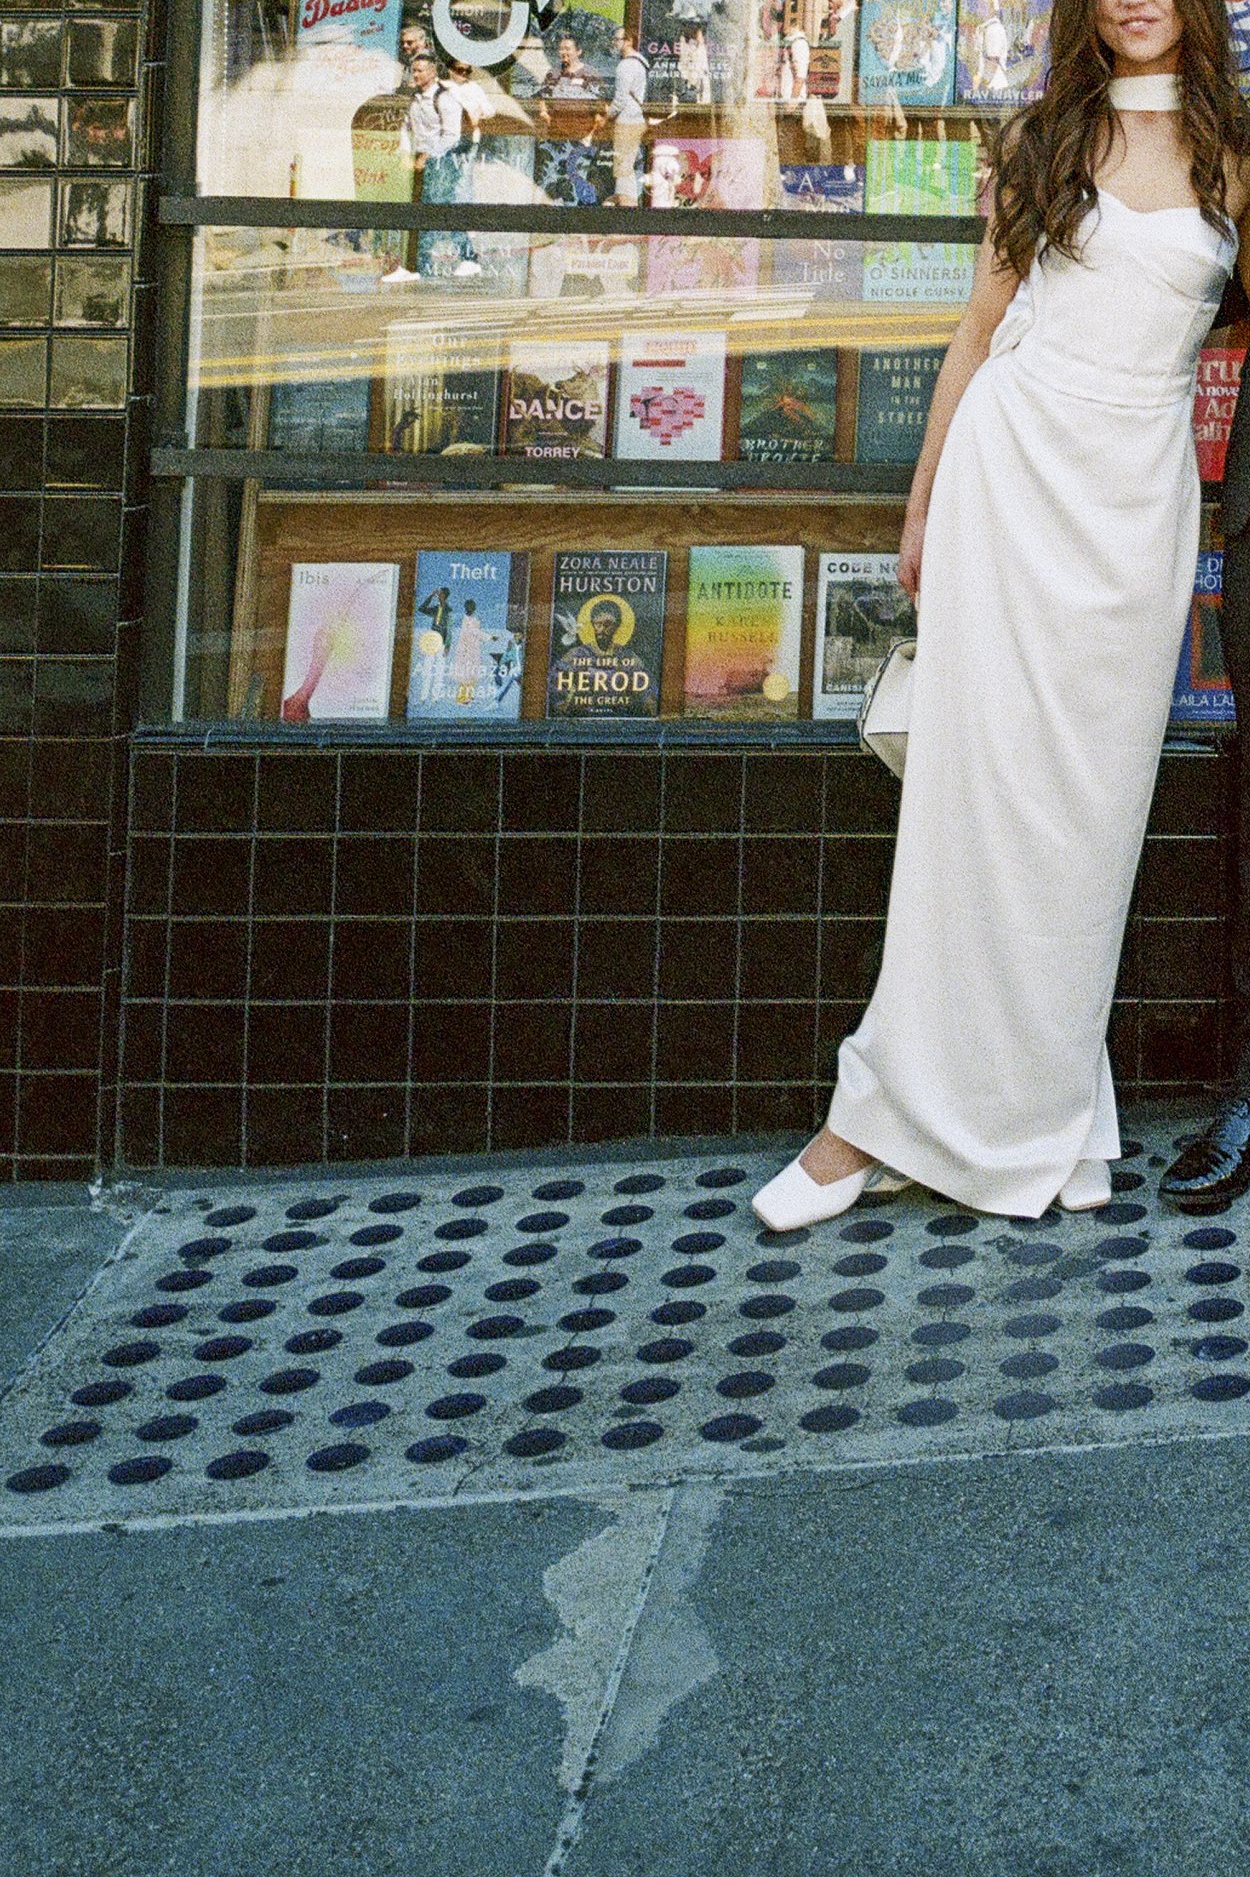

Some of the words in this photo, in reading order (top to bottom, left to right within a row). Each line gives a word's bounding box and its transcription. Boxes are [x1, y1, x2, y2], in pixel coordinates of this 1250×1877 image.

[812, 243, 845, 260] No
[801, 263, 845, 283] Title
[870, 287, 919, 298] NICOLE
[431, 334, 468, 348] Our
[873, 358, 940, 371] ANOTHER
[891, 377, 921, 389] MAN
[392, 388, 479, 402] Hollinghurst
[508, 398, 601, 421] DANCE
[877, 411, 928, 424] STREE
[524, 446, 581, 459] TORREY
[560, 556, 601, 570] ZORA
[607, 556, 658, 570] NEALE
[826, 562, 873, 574] CODE
[298, 571, 330, 586] Ibis
[450, 563, 498, 581] Theft
[559, 576, 657, 594] HURSTON
[697, 581, 793, 600] ANTIDOTE
[572, 657, 592, 667] THE
[595, 657, 619, 667] LIFE
[621, 657, 637, 667] OF
[556, 671, 650, 693] HEROD
[574, 696, 596, 705] THE
[598, 696, 631, 705] GREAT
